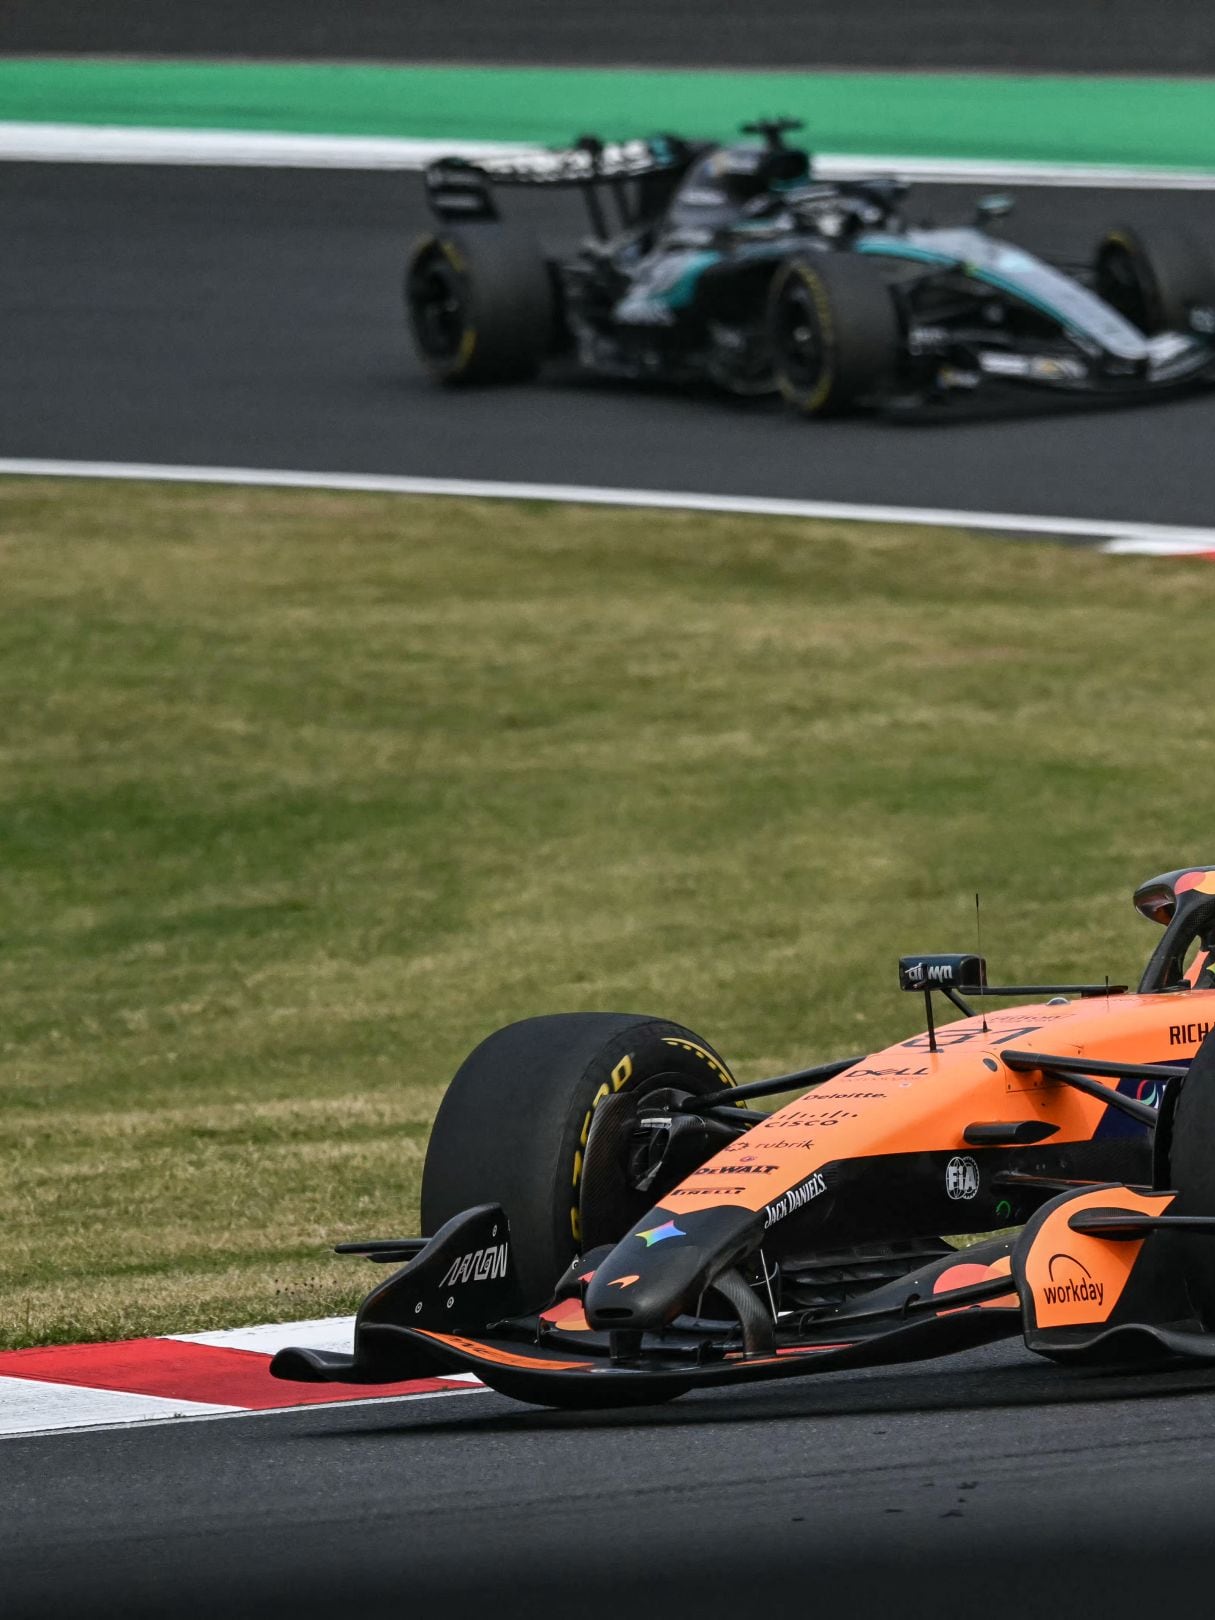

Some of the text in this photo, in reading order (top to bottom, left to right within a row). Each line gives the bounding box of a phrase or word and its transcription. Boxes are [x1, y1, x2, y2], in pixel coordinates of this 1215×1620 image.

[908, 965, 953, 984] alwyn
[1169, 1021, 1214, 1046] RICH
[845, 1067, 929, 1078] DELL
[756, 1138, 815, 1151] rubrik
[948, 1165, 976, 1192] FIA
[670, 1187, 746, 1197] PIRELLI
[764, 1172, 828, 1230] JACK DANIEL'S
[1043, 1277, 1104, 1307] workday
